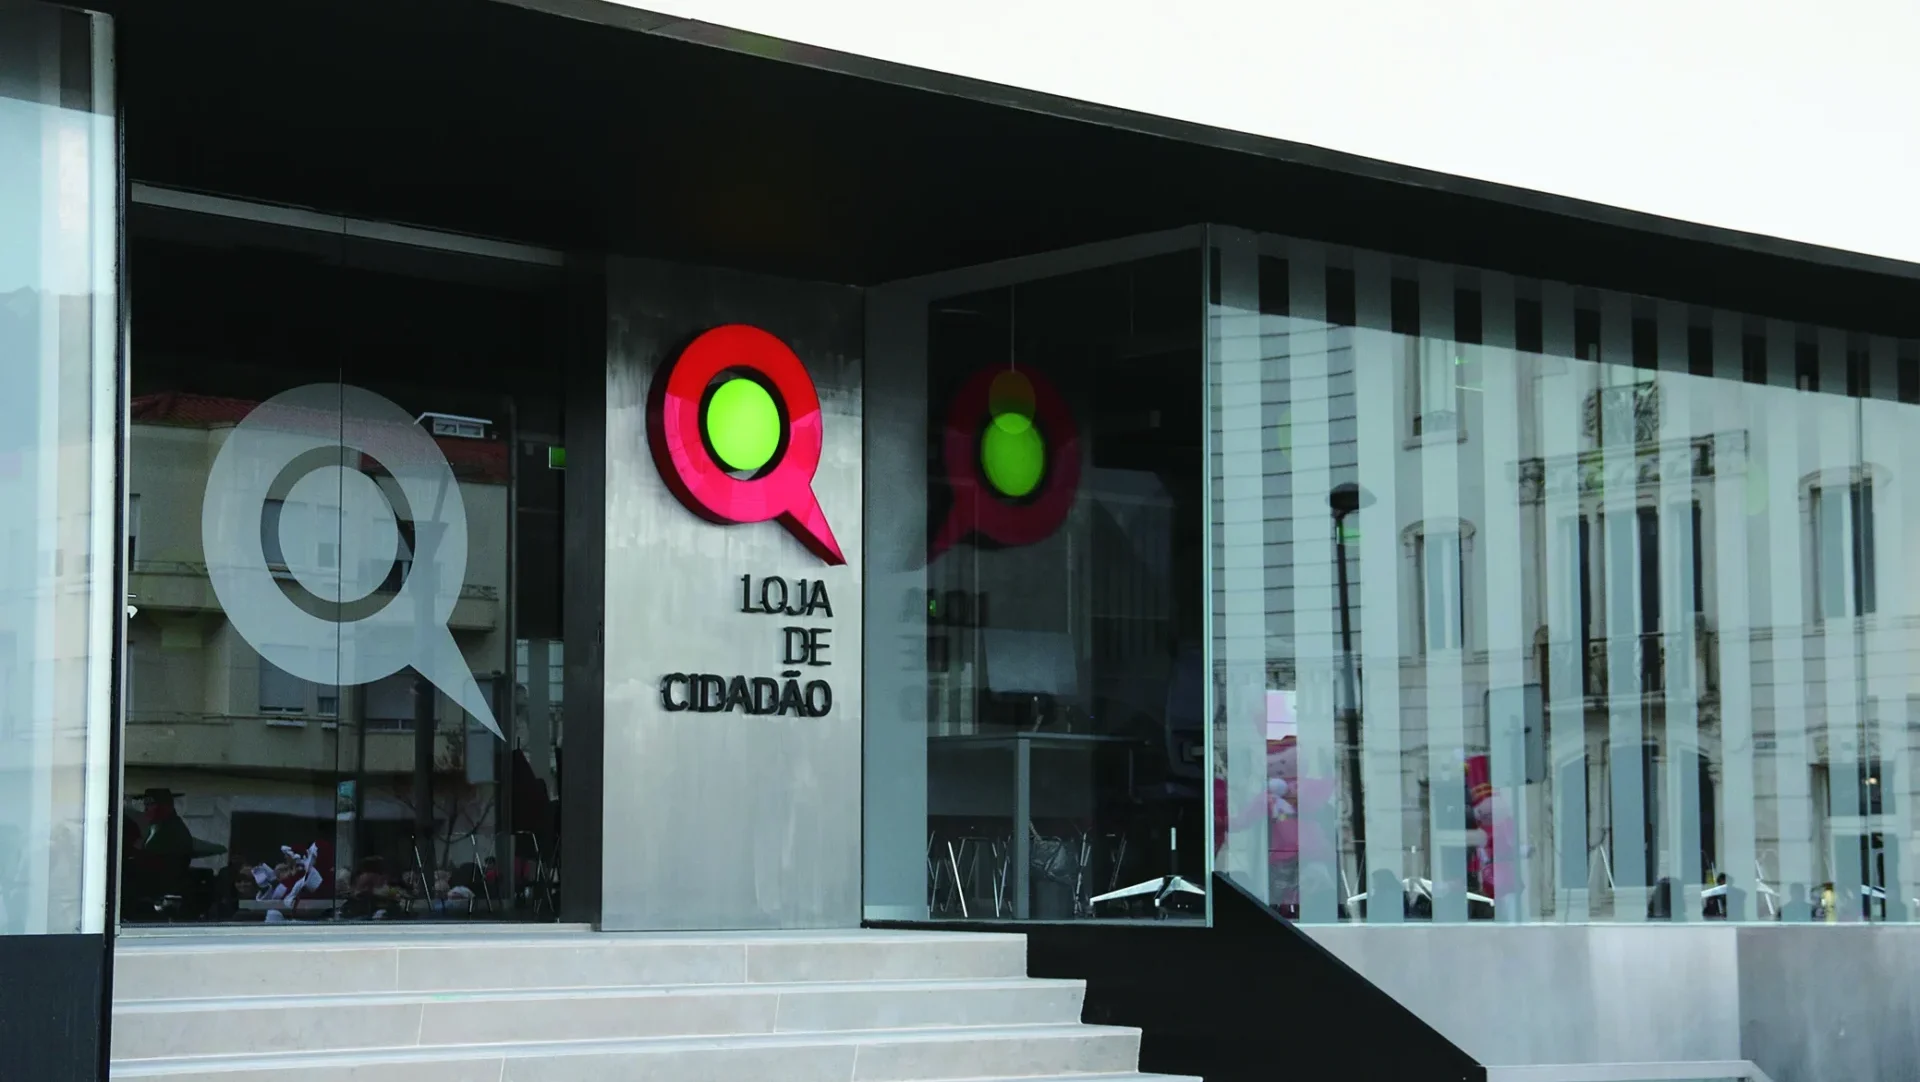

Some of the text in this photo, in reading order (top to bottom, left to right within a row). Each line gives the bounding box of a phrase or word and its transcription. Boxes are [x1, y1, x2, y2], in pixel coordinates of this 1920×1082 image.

[741, 574, 833, 617] LOJA
[783, 626, 832, 666] DE
[660, 670, 833, 717] CIDADÃO
